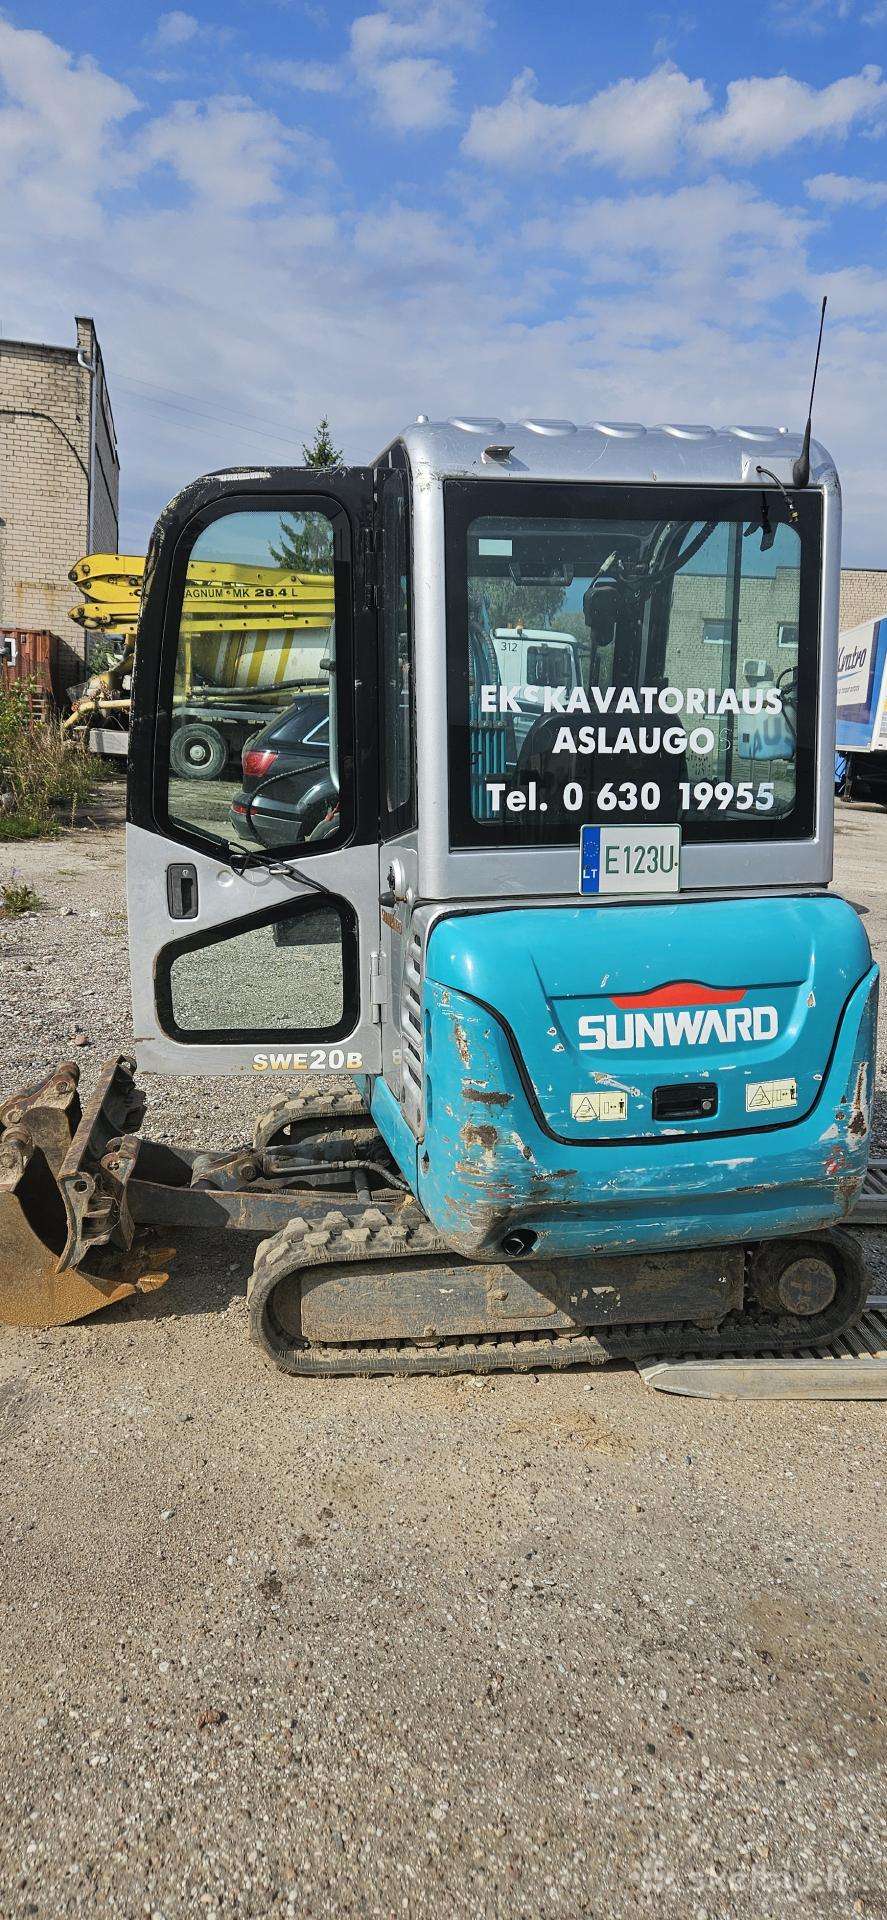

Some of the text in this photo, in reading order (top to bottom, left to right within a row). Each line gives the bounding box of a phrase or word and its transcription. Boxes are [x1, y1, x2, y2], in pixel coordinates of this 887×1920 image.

[185, 587, 298, 598] AGNUM MK 28.4 L
[501, 641, 518, 652] 312
[486, 781, 775, 812] Tel. 0 630 19955
[605, 845, 674, 874] E123U
[583, 869, 598, 879] LT
[578, 1006, 779, 1051] SUNWARD
[252, 1049, 364, 1072] SWE20B
